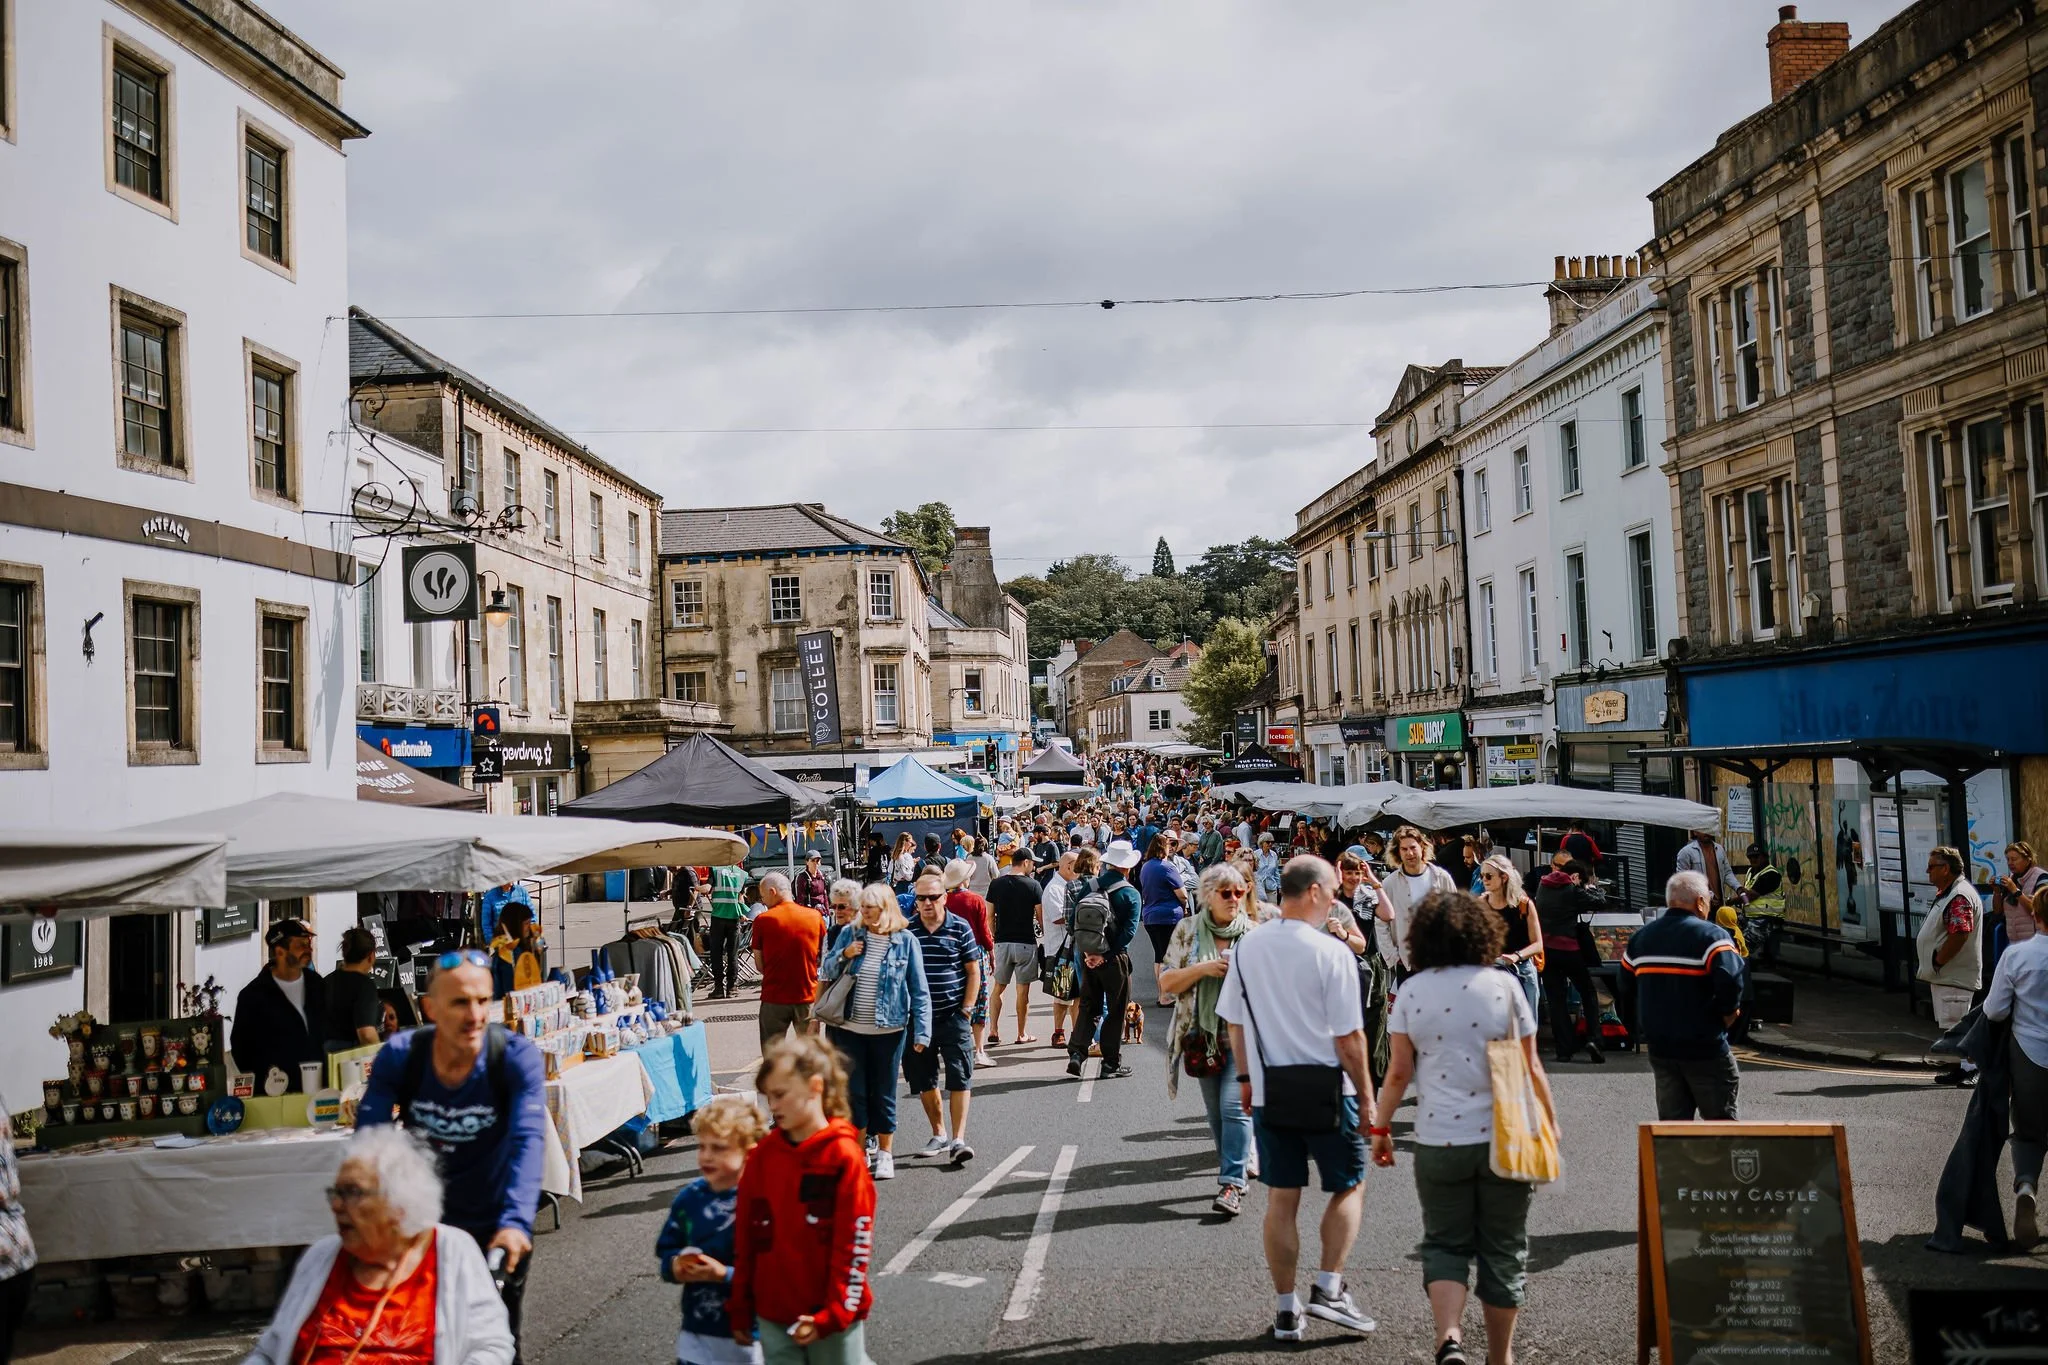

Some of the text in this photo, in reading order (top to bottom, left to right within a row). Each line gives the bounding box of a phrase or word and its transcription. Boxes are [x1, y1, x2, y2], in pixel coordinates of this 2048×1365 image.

[142, 516, 190, 544] FATFACE
[808, 638, 829, 720] COFFEE
[1408, 719, 1446, 745] SUBWAY
[391, 740, 433, 757] nationwide
[488, 739, 544, 767] Sperdrug
[899, 803, 956, 820] TOASTIES
[34, 953, 54, 969] 1988
[1690, 1206, 1812, 1215] VINEYARD
[1710, 1233, 1750, 1245] Sparkling
[1693, 1246, 1733, 1258] Sparkling
[1758, 1247, 1769, 1257] de
[1760, 1280, 1782, 1289] 2022
[1764, 1293, 1785, 1302] 2022
[1715, 1304, 1737, 1314] Pinot
[1738, 1304, 1757, 1314] Noir
[1726, 1317, 1749, 1328] Pinot
[1750, 1318, 1770, 1328] Noir
